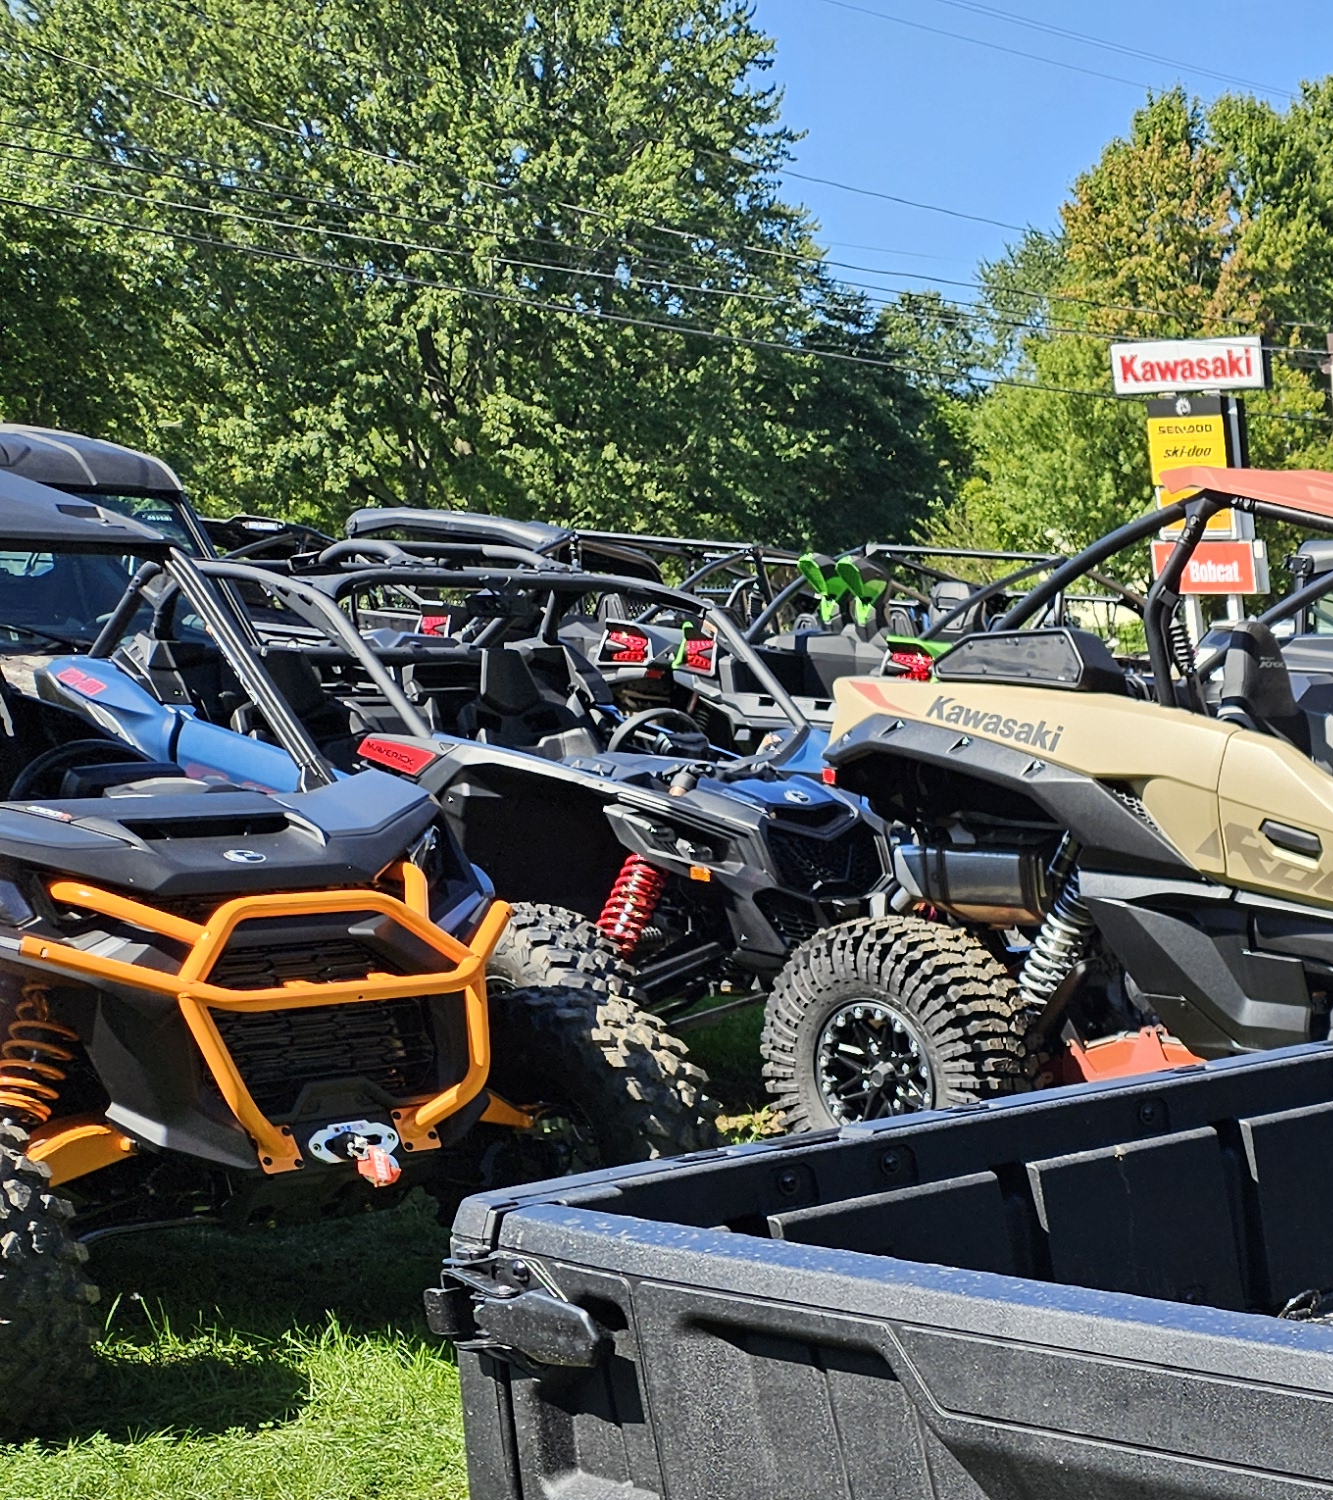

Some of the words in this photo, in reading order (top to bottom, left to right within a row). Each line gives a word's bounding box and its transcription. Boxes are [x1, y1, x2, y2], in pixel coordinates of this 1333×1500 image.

[1119, 346, 1253, 384] Kawasaki
[1189, 560, 1240, 583] Bobcat
[925, 695, 1065, 753] Kawasaki
